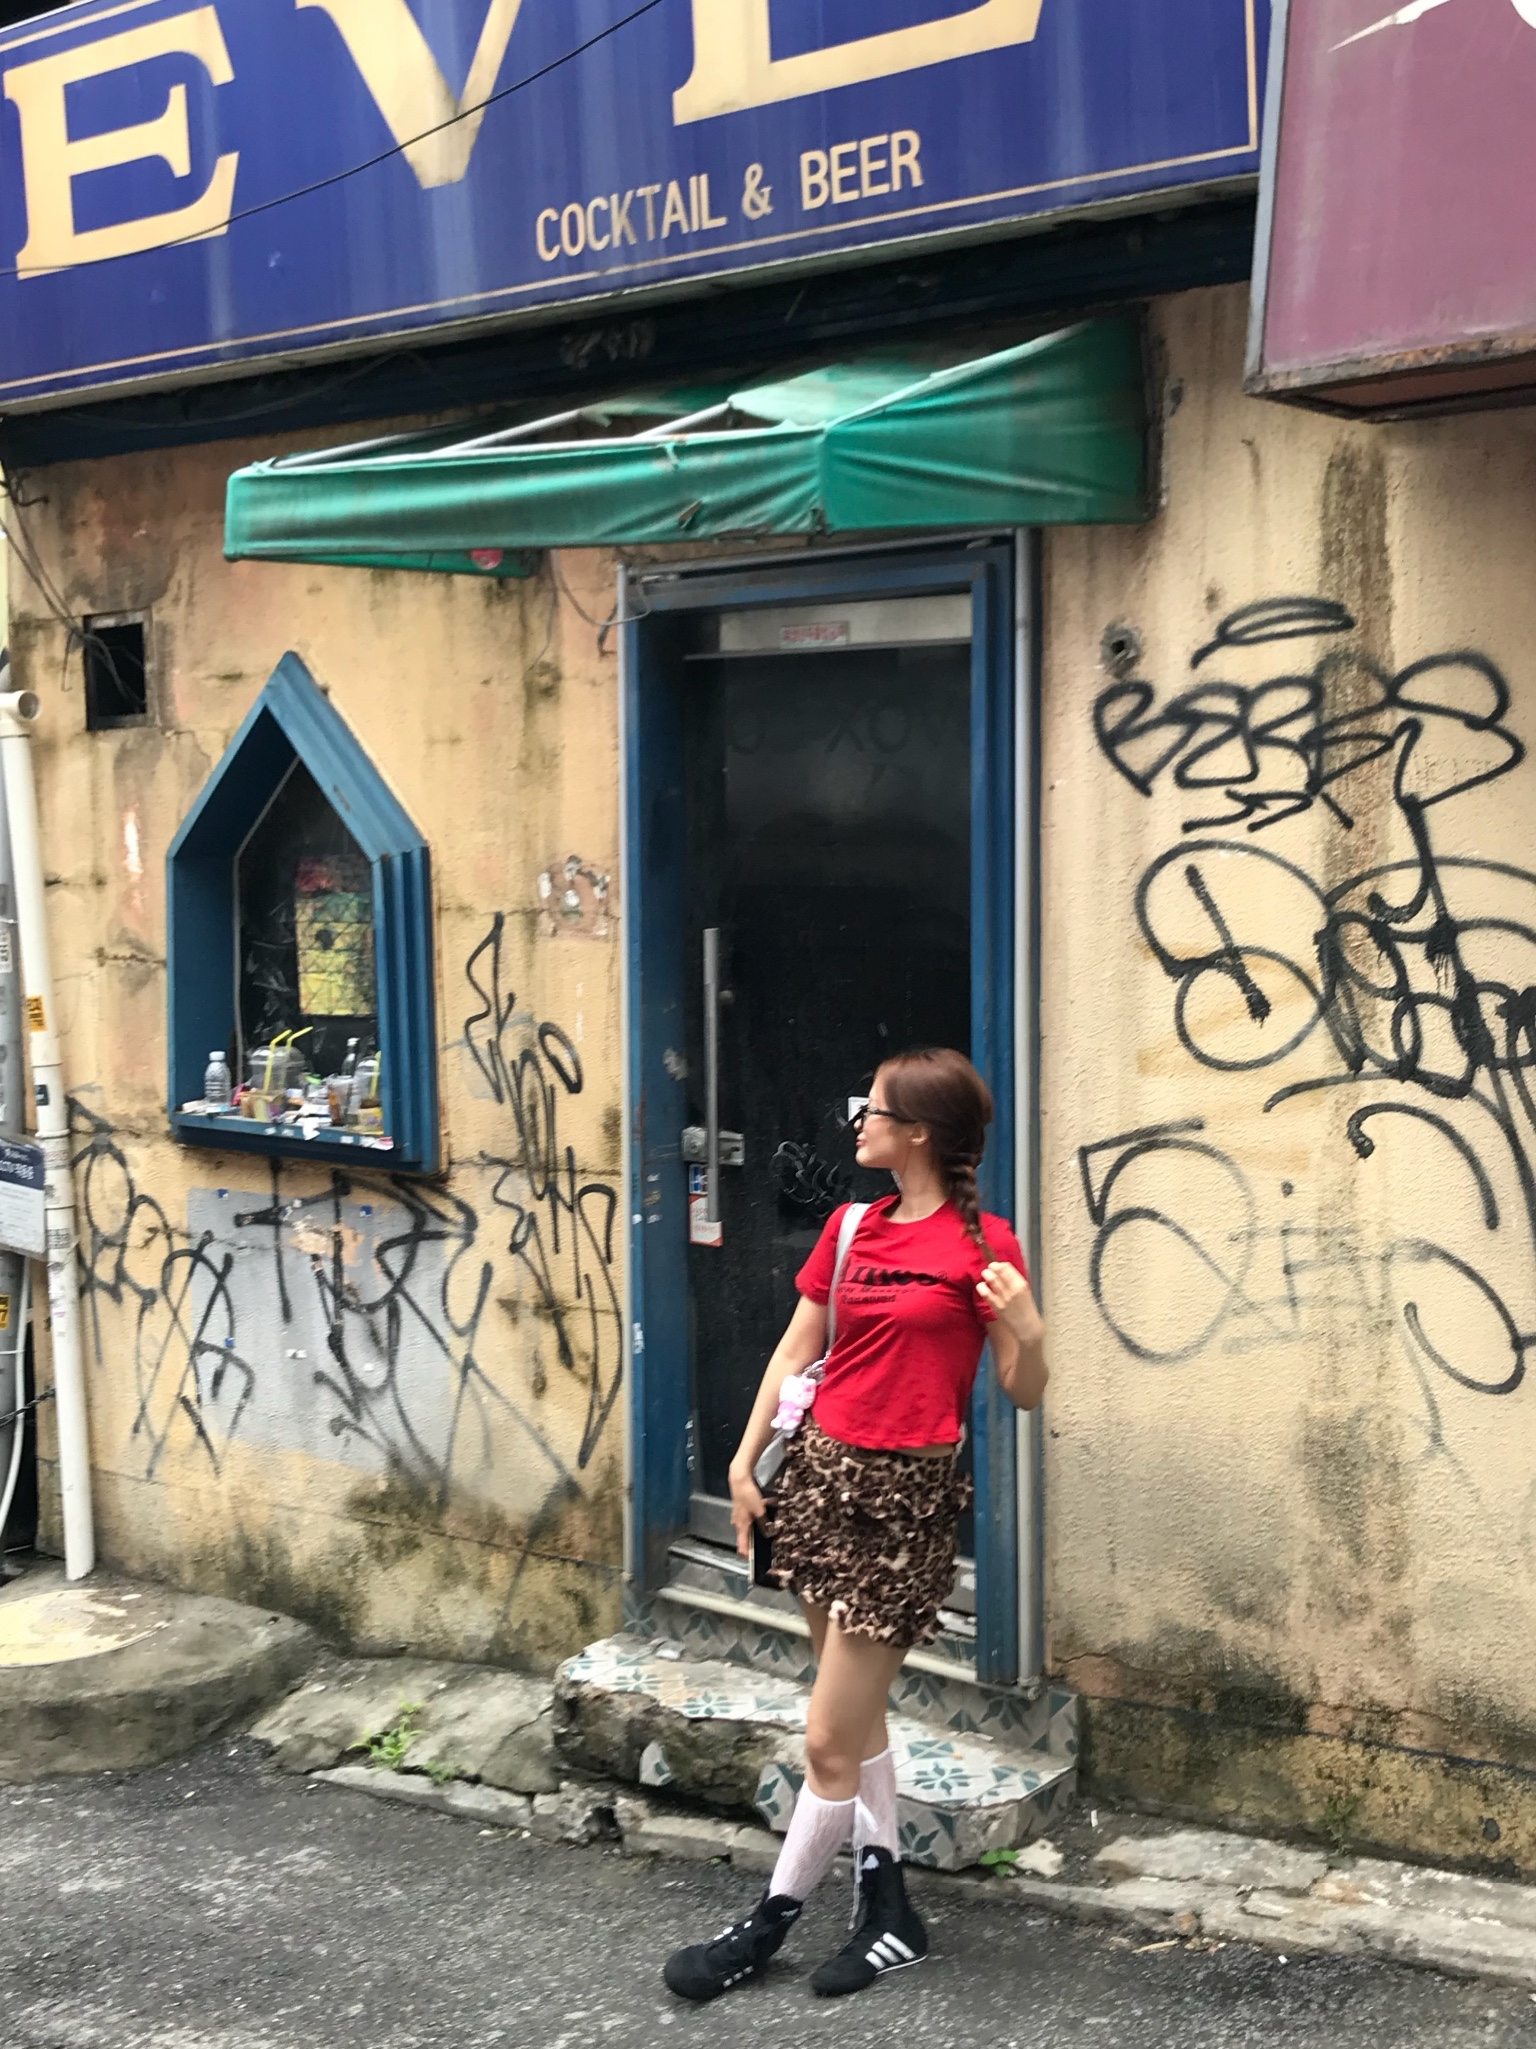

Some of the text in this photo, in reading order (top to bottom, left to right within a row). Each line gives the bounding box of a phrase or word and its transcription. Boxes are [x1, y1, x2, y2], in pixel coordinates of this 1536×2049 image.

[535, 129, 924, 262] COCKTAIL & BEER
